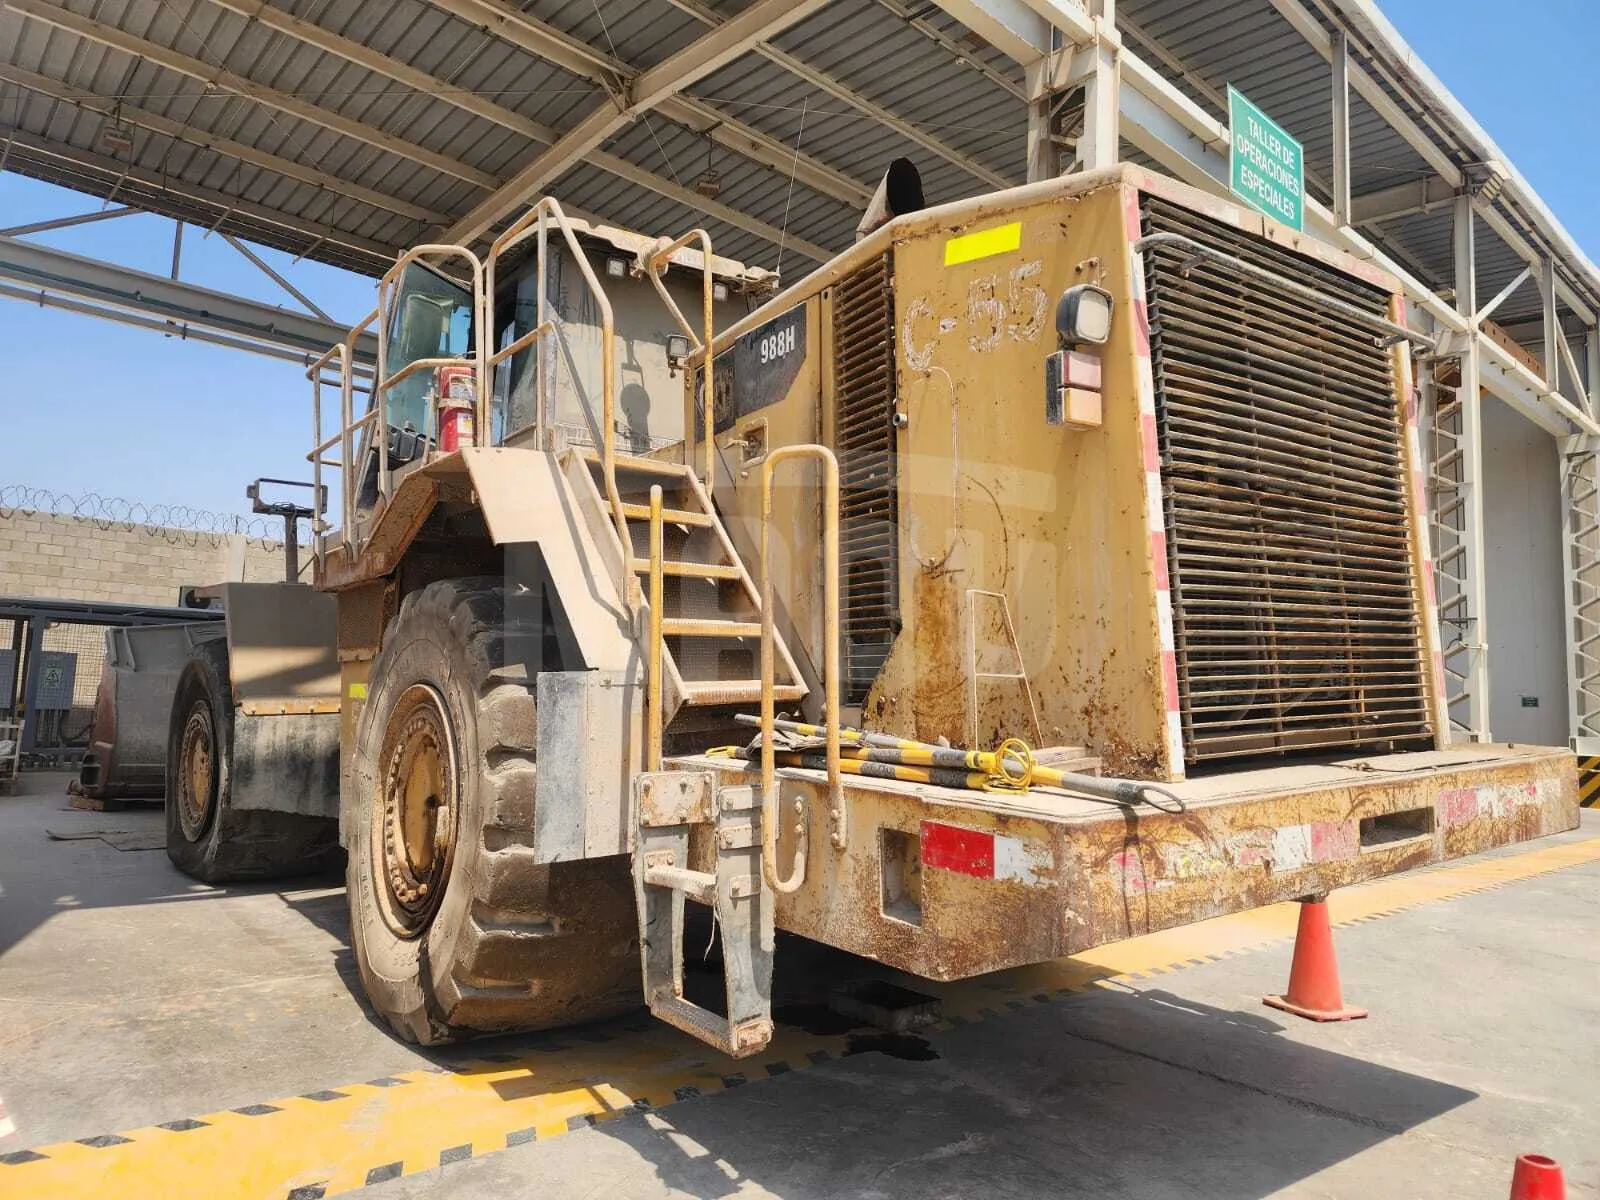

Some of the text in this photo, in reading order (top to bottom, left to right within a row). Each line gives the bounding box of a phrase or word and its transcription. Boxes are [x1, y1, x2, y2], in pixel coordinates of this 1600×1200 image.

[1236, 135, 1300, 197] OPERACIONES
[1247, 116, 1295, 170] TALLER DE
[1240, 164, 1295, 220] ESPECIALES
[760, 325, 796, 365] 988H
